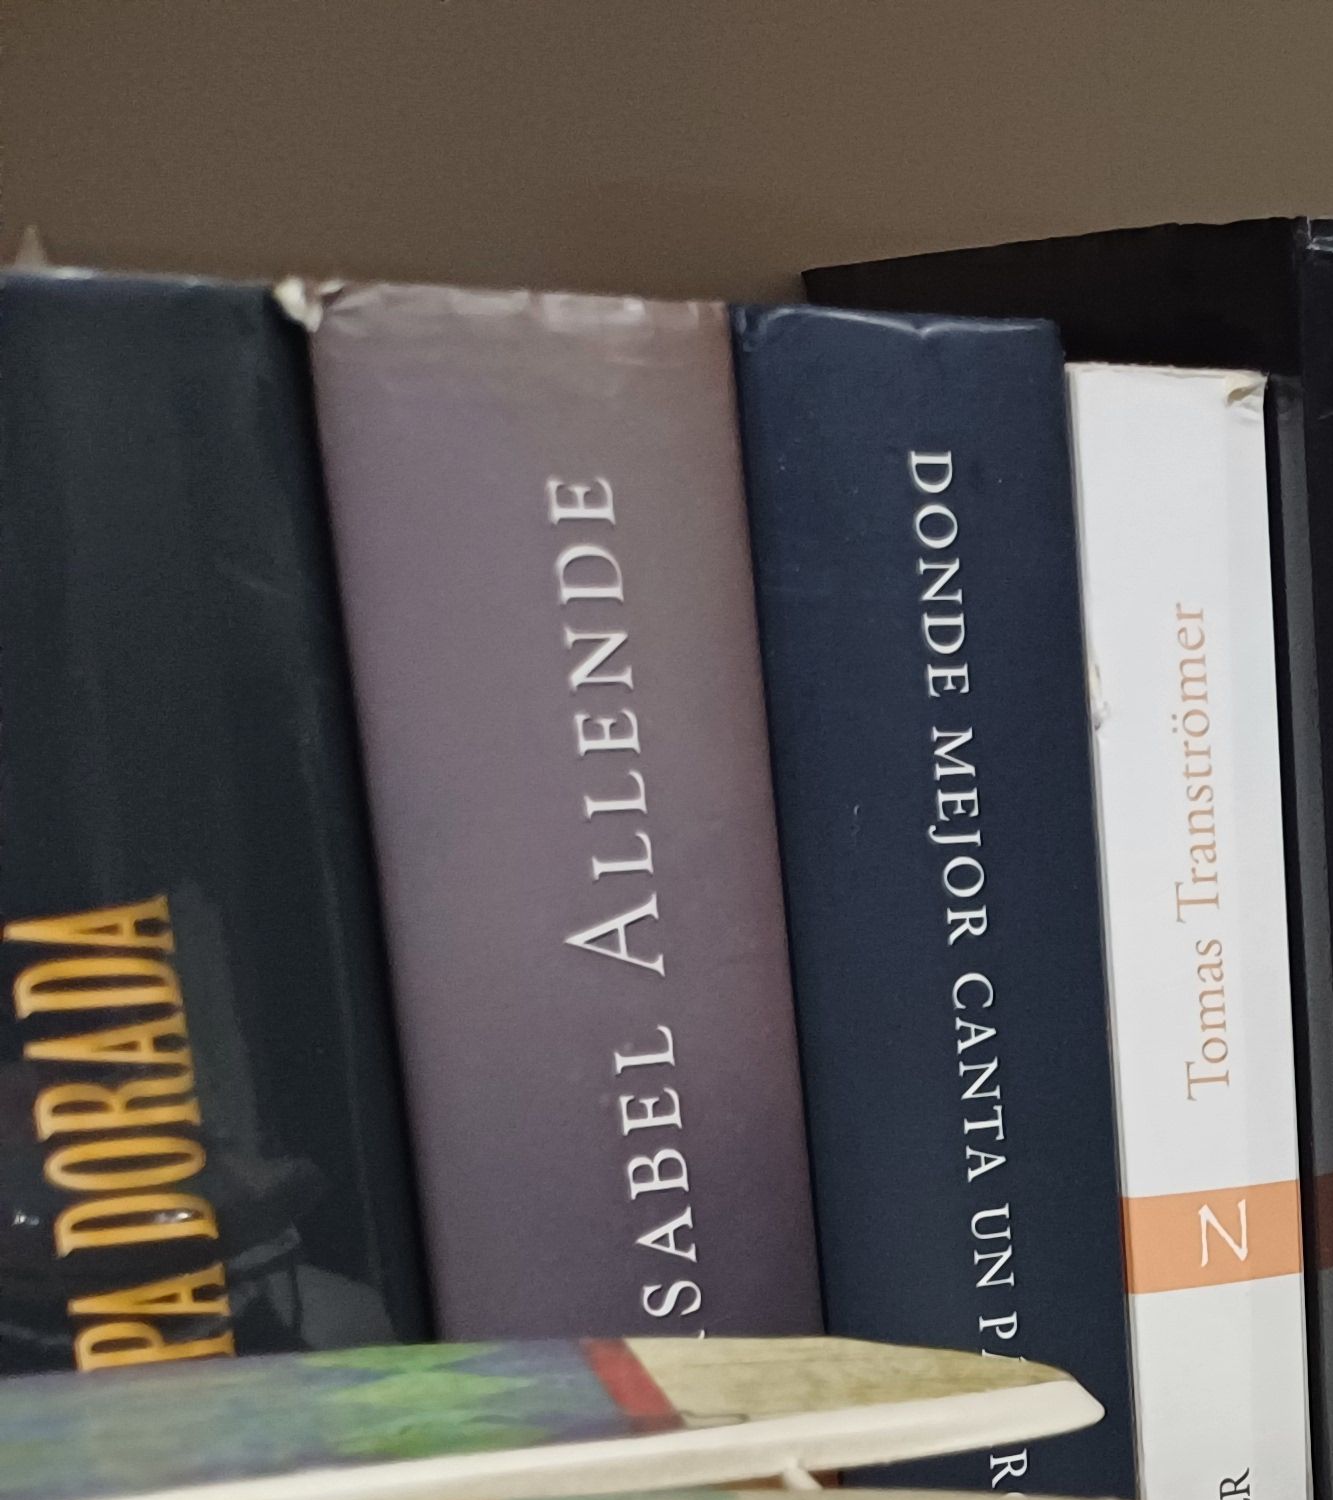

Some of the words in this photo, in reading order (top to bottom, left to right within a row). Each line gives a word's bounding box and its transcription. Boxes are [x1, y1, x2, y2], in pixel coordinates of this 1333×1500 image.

[908, 450, 970, 697] DONDE
[547, 476, 666, 977] ALLENDE
[928, 726, 988, 945] MEJOR
[1172, 603, 1220, 925] Tranströmer
[4, 894, 219, 1258] DORADA
[952, 972, 1006, 1182] CANTA
[1185, 939, 1230, 1101] Tomas
[614, 1024, 706, 1340] SABEL
[970, 1203, 1017, 1289] UN
